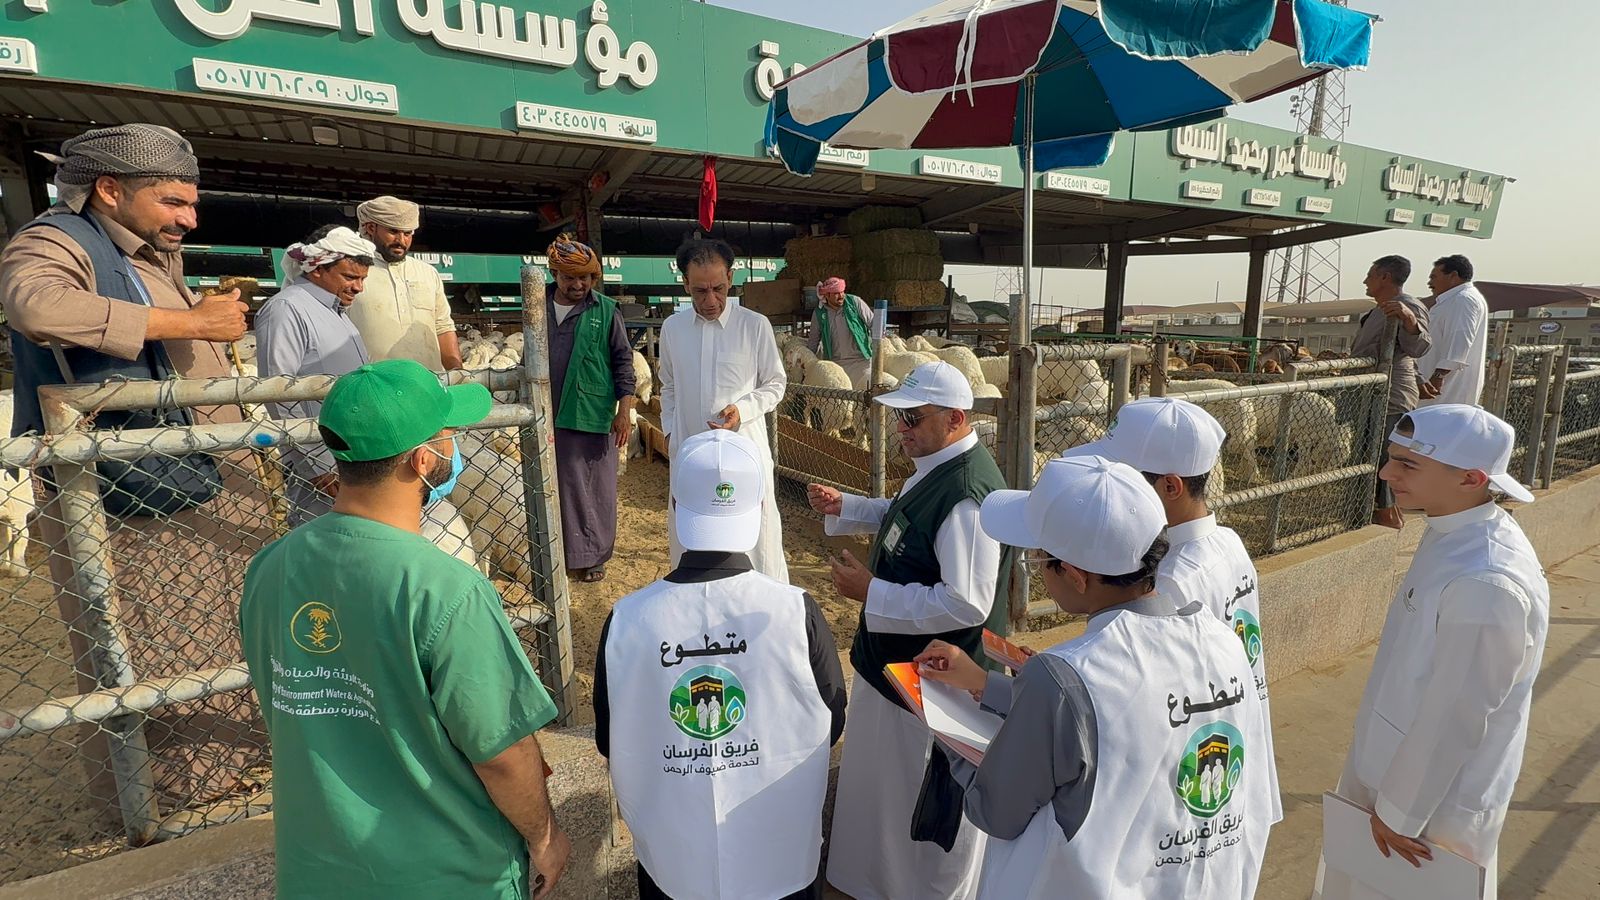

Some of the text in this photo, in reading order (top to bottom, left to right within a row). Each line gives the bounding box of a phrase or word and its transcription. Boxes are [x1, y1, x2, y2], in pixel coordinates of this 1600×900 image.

[336, 84, 389, 106] جوال:
[846, 150, 866, 163] رقم
[1232, 137, 1268, 174] محمد
[660, 632, 748, 667] متطوع
[285, 665, 331, 682] والمياه
[325, 688, 347, 699] Water
[1167, 675, 1244, 728] متطوع
[295, 703, 340, 717] بمنطقة
[663, 738, 759, 761] فريق الفرسان
[663, 757, 759, 776] لخدمة ضيوف الرحمن
[1158, 818, 1218, 850] الفرسان
[1155, 850, 1193, 867] الرحمن
